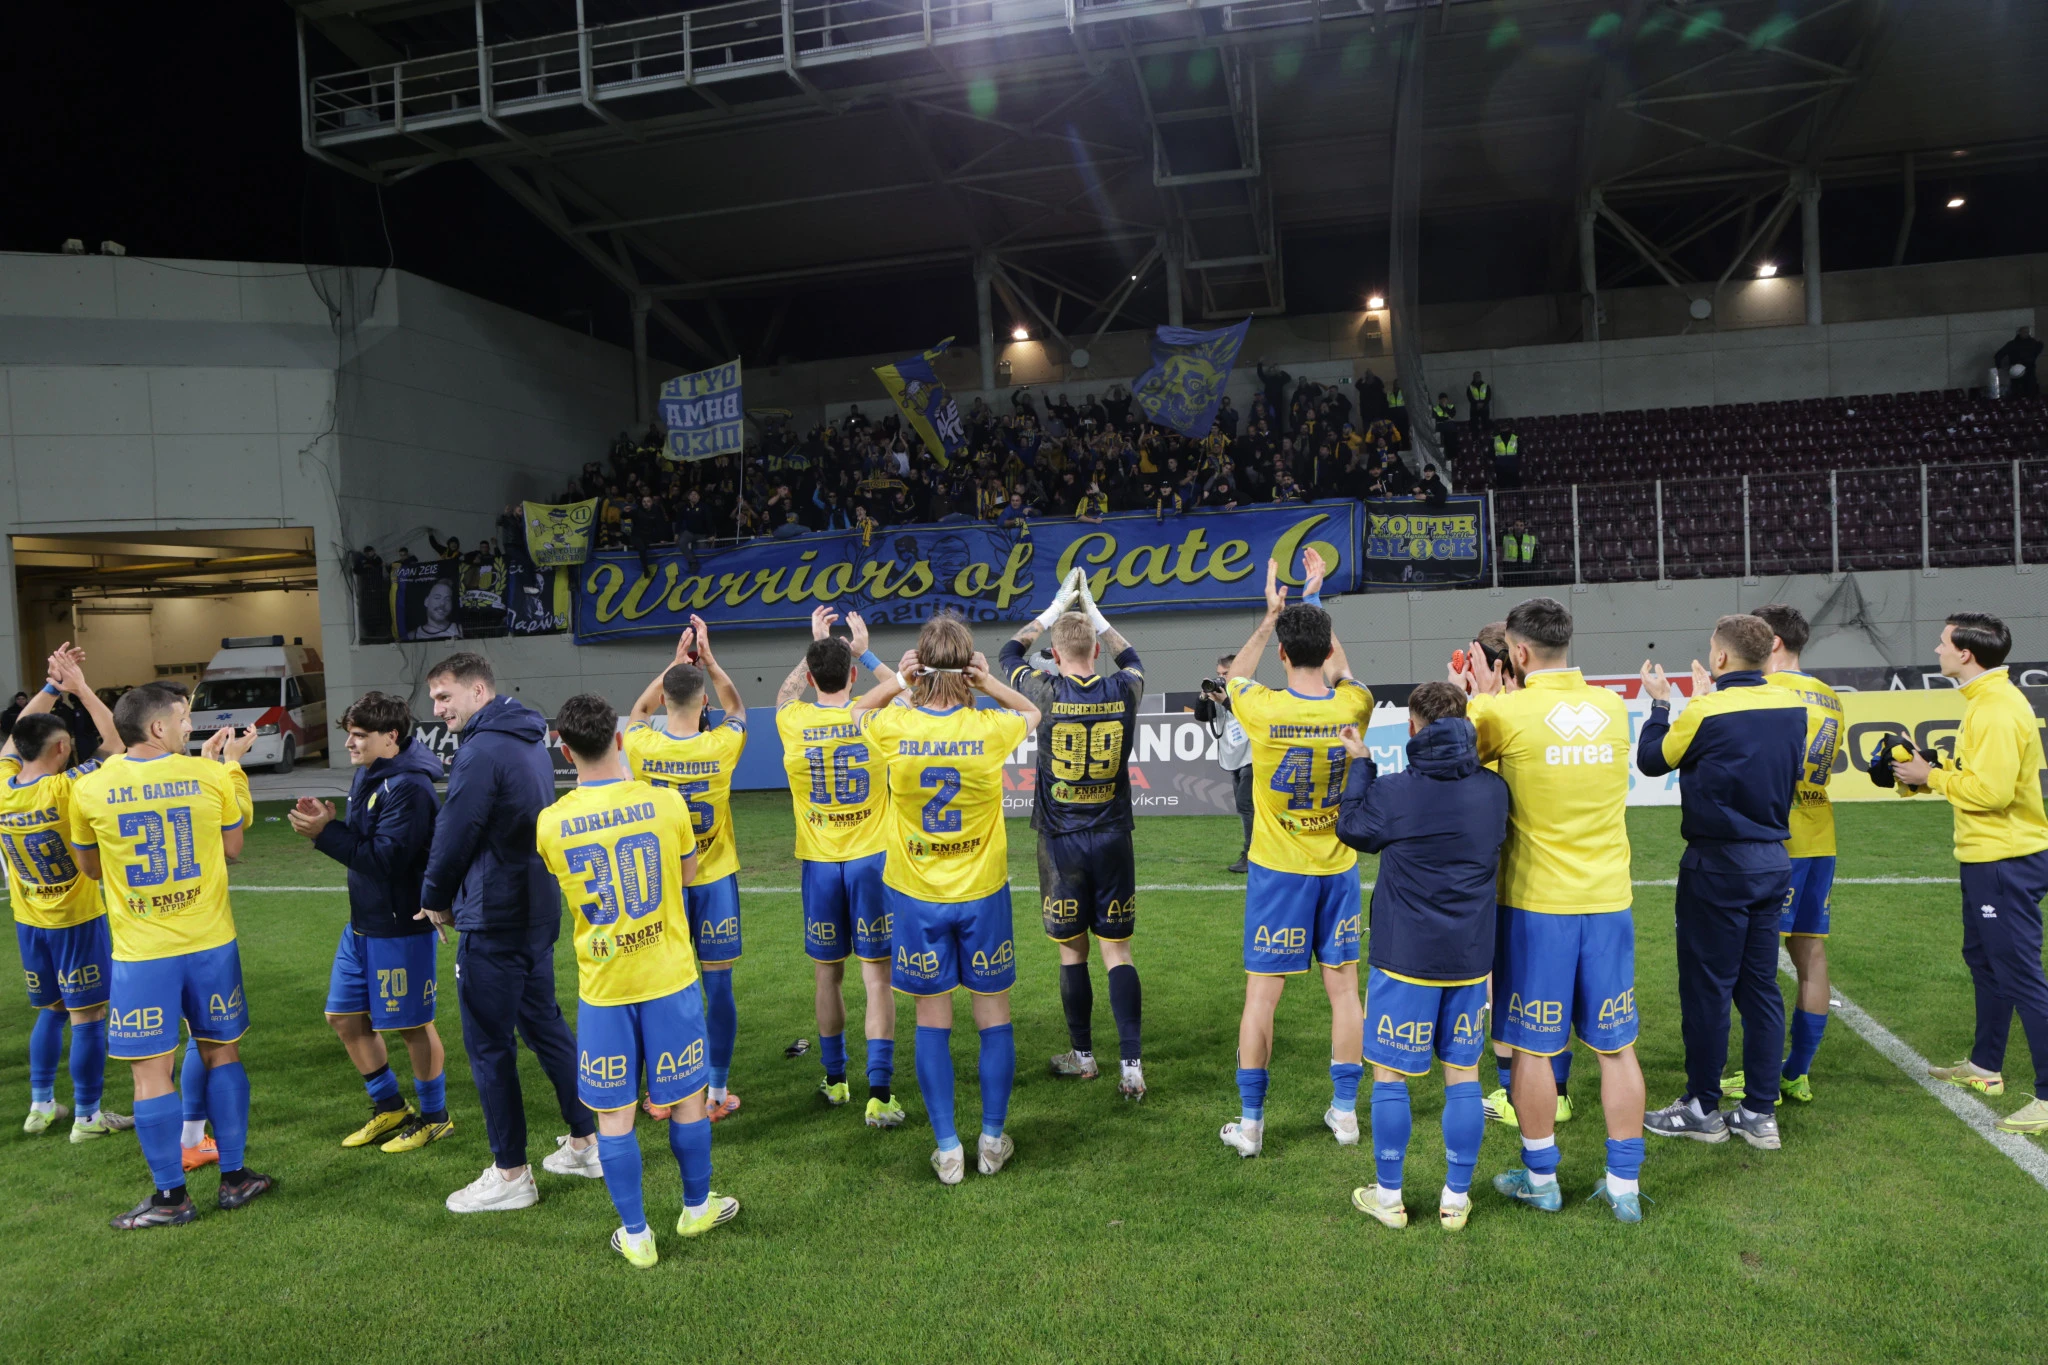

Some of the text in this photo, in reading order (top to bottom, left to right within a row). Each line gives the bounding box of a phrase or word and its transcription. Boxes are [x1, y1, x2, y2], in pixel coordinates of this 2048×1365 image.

[1369, 514, 1476, 535] YOUTH
[1368, 537, 1477, 558] BLOCK
[586, 513, 1340, 622] Warriors of Gate 6
[899, 740, 985, 756] GRANATH
[1051, 720, 1124, 781] 99
[642, 758, 721, 775] MANRIQUE
[804, 743, 870, 804] 16
[1271, 746, 1347, 810] 41
[107, 779, 202, 805] J.M. GARCIA
[920, 766, 962, 833] 2
[560, 802, 656, 838] ADRIANO
[1301, 811, 1339, 827] ΕΝΩΣ
[1, 829, 78, 885] 18
[118, 806, 202, 888] 31
[931, 838, 981, 853] ΕΝΩΣΗ
[563, 832, 663, 926] 30
[1043, 895, 1079, 918] A4B
[615, 920, 663, 948] ΕΝΩΣΗ
[701, 916, 739, 938] A4B
[1254, 925, 1307, 948] A4B
[898, 945, 940, 973] A4B
[971, 940, 1014, 970] A4B
[1271, 947, 1305, 955] BUILDINGS
[377, 968, 408, 998] 70
[910, 971, 940, 980] BUILDINGS
[110, 1007, 164, 1030] A4B
[1509, 992, 1563, 1025] A4B
[124, 1029, 164, 1038] BUILDINGS
[1377, 1014, 1433, 1045] A4B
[1525, 1021, 1562, 1032] BUILDINGS
[1377, 1036, 1389, 1045] ART
[1396, 1043, 1431, 1052] BUILDINGS
[1453, 1036, 1467, 1044] ART
[580, 1050, 627, 1080] A4B
[656, 1038, 704, 1075] A4B
[678, 1060, 704, 1080] BUILDINGS
[591, 1079, 627, 1089] BUILDINGS
